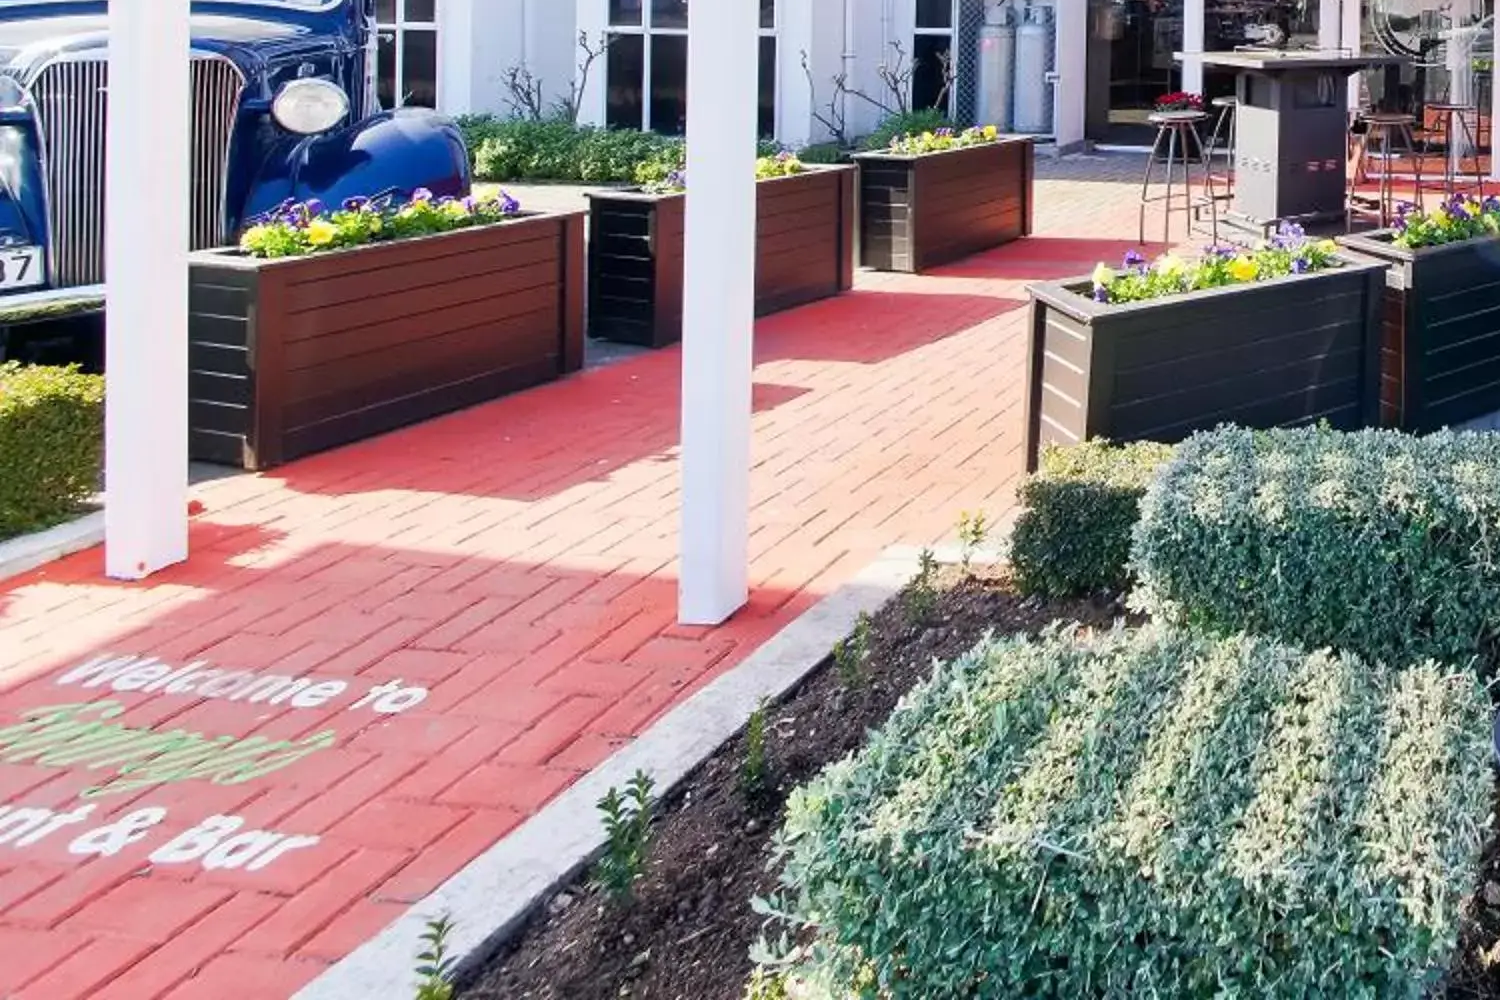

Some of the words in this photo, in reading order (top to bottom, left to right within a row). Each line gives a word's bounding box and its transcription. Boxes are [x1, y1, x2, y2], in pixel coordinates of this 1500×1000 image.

[57, 652, 348, 708] Welcome
[349, 678, 428, 713] to
[68, 806, 168, 857] &
[148, 813, 321, 871] Bar
